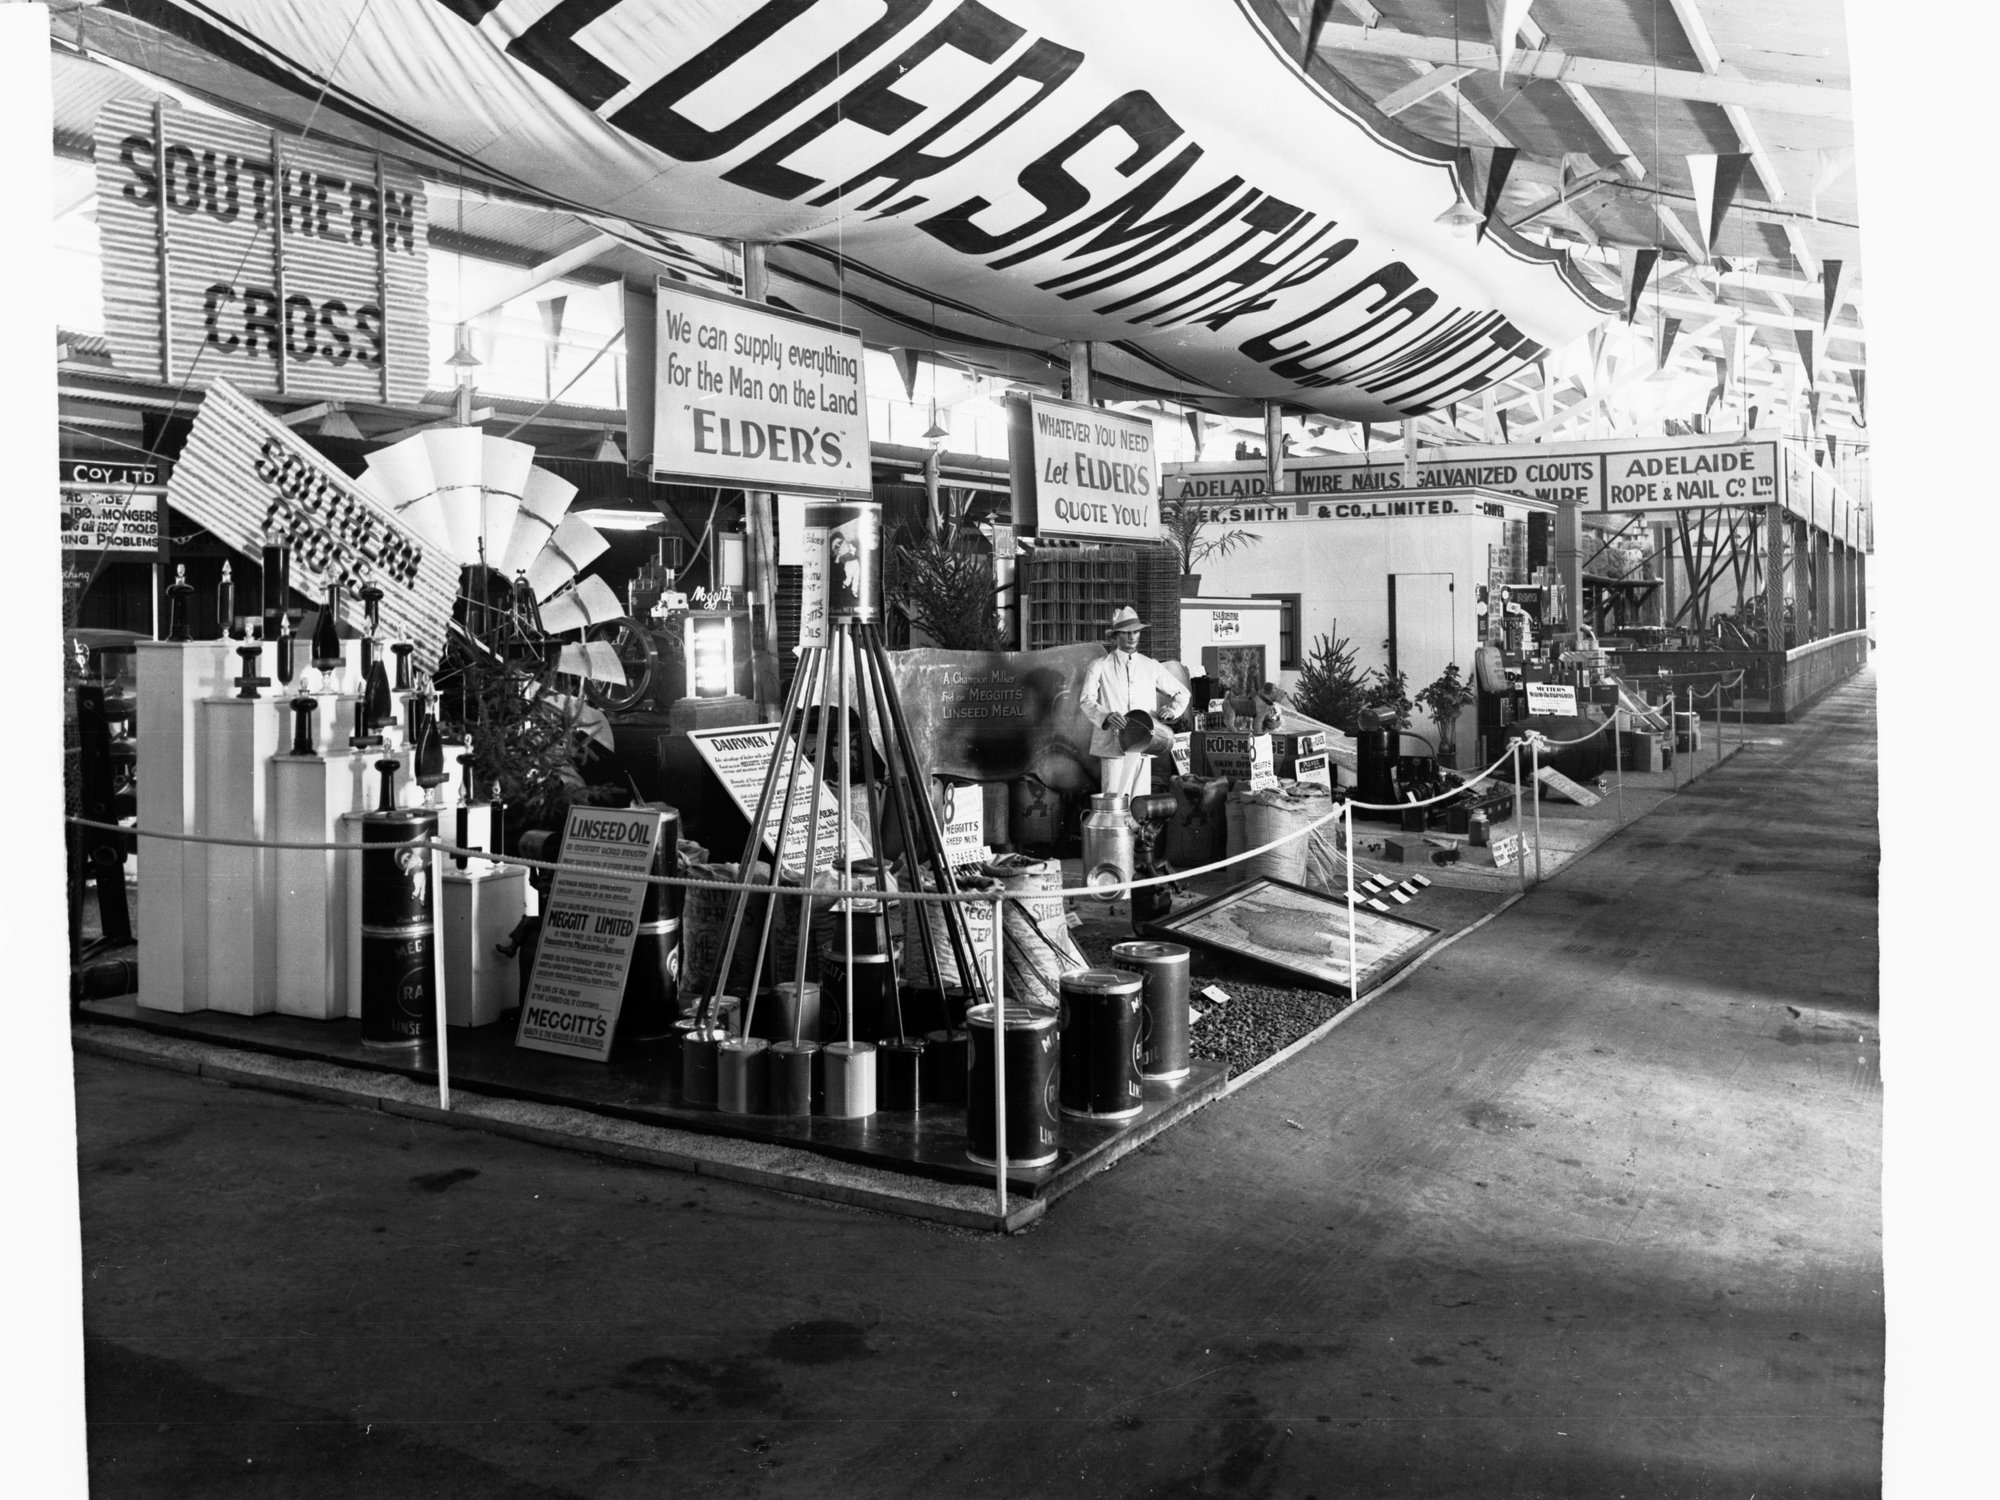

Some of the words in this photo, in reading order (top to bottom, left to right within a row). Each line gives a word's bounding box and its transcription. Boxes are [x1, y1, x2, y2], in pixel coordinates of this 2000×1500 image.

[119, 135, 415, 255] SOUTHERN
[914, 90, 1338, 328] SMITH
[204, 282, 382, 370] CROSS
[666, 309, 692, 344] We
[698, 325, 727, 352] can
[734, 333, 782, 370] supply
[788, 344, 858, 385] everything
[668, 352, 692, 387] for
[698, 360, 723, 394] the
[729, 365, 763, 400] Man
[769, 382, 788, 405] on
[794, 379, 816, 409] the
[820, 383, 858, 416] Land
[1038, 412, 1091, 444] WHATEVER
[1095, 424, 1116, 448] YOU
[1120, 429, 1149, 453] NEED
[1044, 457, 1068, 485] Let
[1075, 452, 1150, 496] ELDER'S
[1302, 473, 1342, 493] WIRE
[1416, 465, 1518, 488] GALVANIZED
[1526, 461, 1594, 483] CLOUTS
[1626, 452, 1755, 478] ADELAIDE
[1181, 477, 1267, 498] ADELAID
[1611, 483, 1657, 504] ROPE
[1662, 487, 1673, 501] &
[1677, 480, 1720, 500] NAIL
[255, 437, 422, 590] SOUTHERN
[1055, 498, 1109, 523] QUOTE
[1111, 503, 1148, 528] YOU!
[1229, 507, 1288, 522] SMITH
[1317, 505, 1332, 519] &
[97, 533, 159, 548] PROBLEMS
[122, 524, 157, 534] TOOLS
[943, 671, 951, 685] A
[943, 706, 989, 719] LINSEED
[570, 816, 627, 841] LINSEED
[628, 821, 650, 845] OIL
[547, 910, 589, 931] MEGGITT
[595, 916, 634, 937] LIMITED
[526, 1006, 607, 1037] MEGGITT'S
